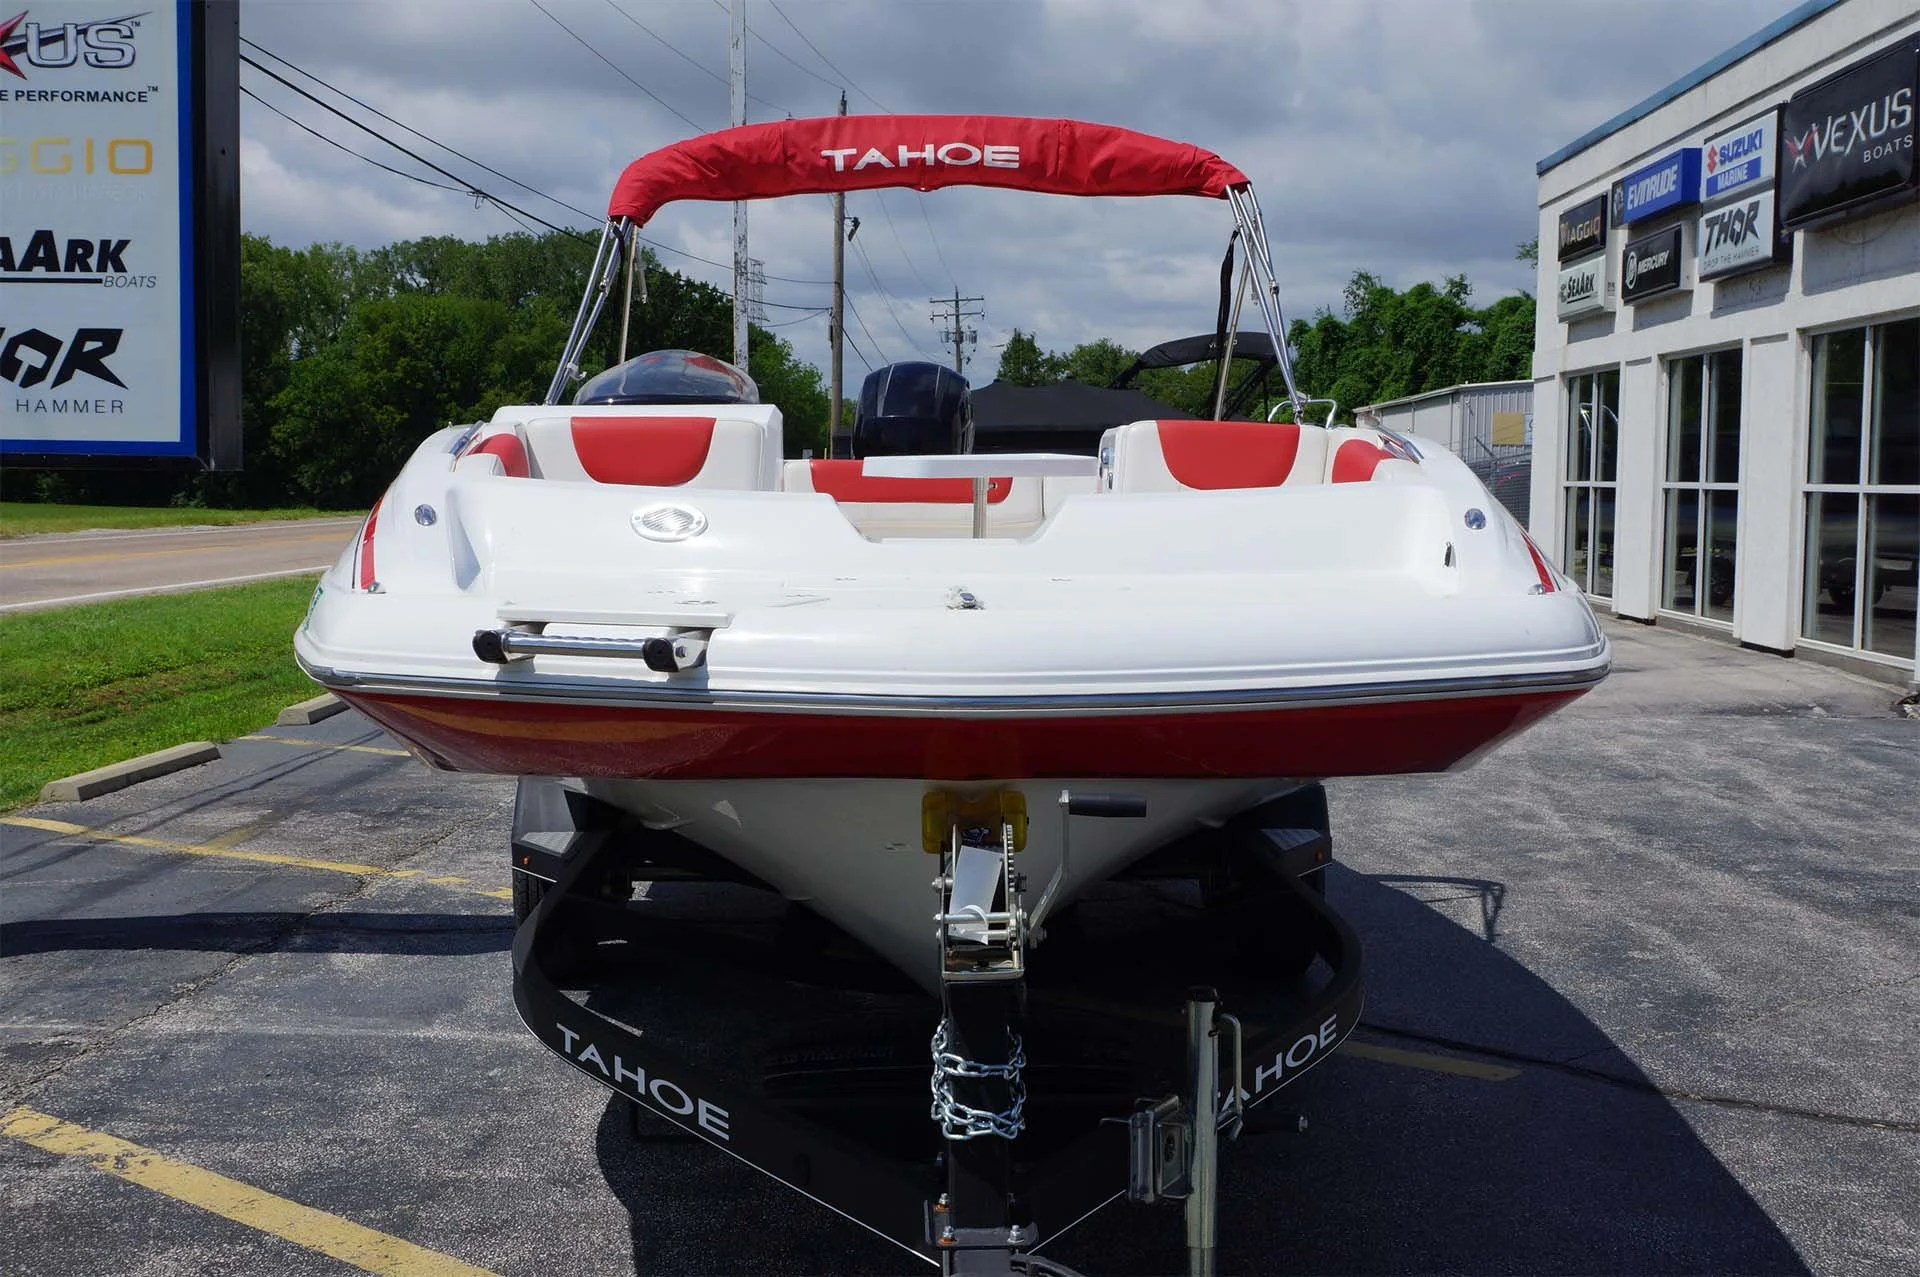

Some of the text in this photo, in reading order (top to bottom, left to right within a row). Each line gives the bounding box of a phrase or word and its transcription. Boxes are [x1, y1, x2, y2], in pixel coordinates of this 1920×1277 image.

[1814, 88, 1912, 161] VEXUS
[821, 142, 1020, 173] TAHOE
[1719, 128, 1763, 166] SUZUKI
[1863, 134, 1914, 164] BOATS
[1627, 164, 1678, 210] EVINRUDE
[1717, 163, 1748, 192] MARINE
[1560, 216, 1601, 248] VIAGGIO
[1705, 200, 1760, 257] THOR
[1637, 250, 1670, 275] MERCURY
[103, 275, 157, 289] BOATS
[15, 399, 124, 414] HAMMER
[1218, 1014, 1337, 1112] AHOE
[556, 1022, 730, 1141] TAHOE
